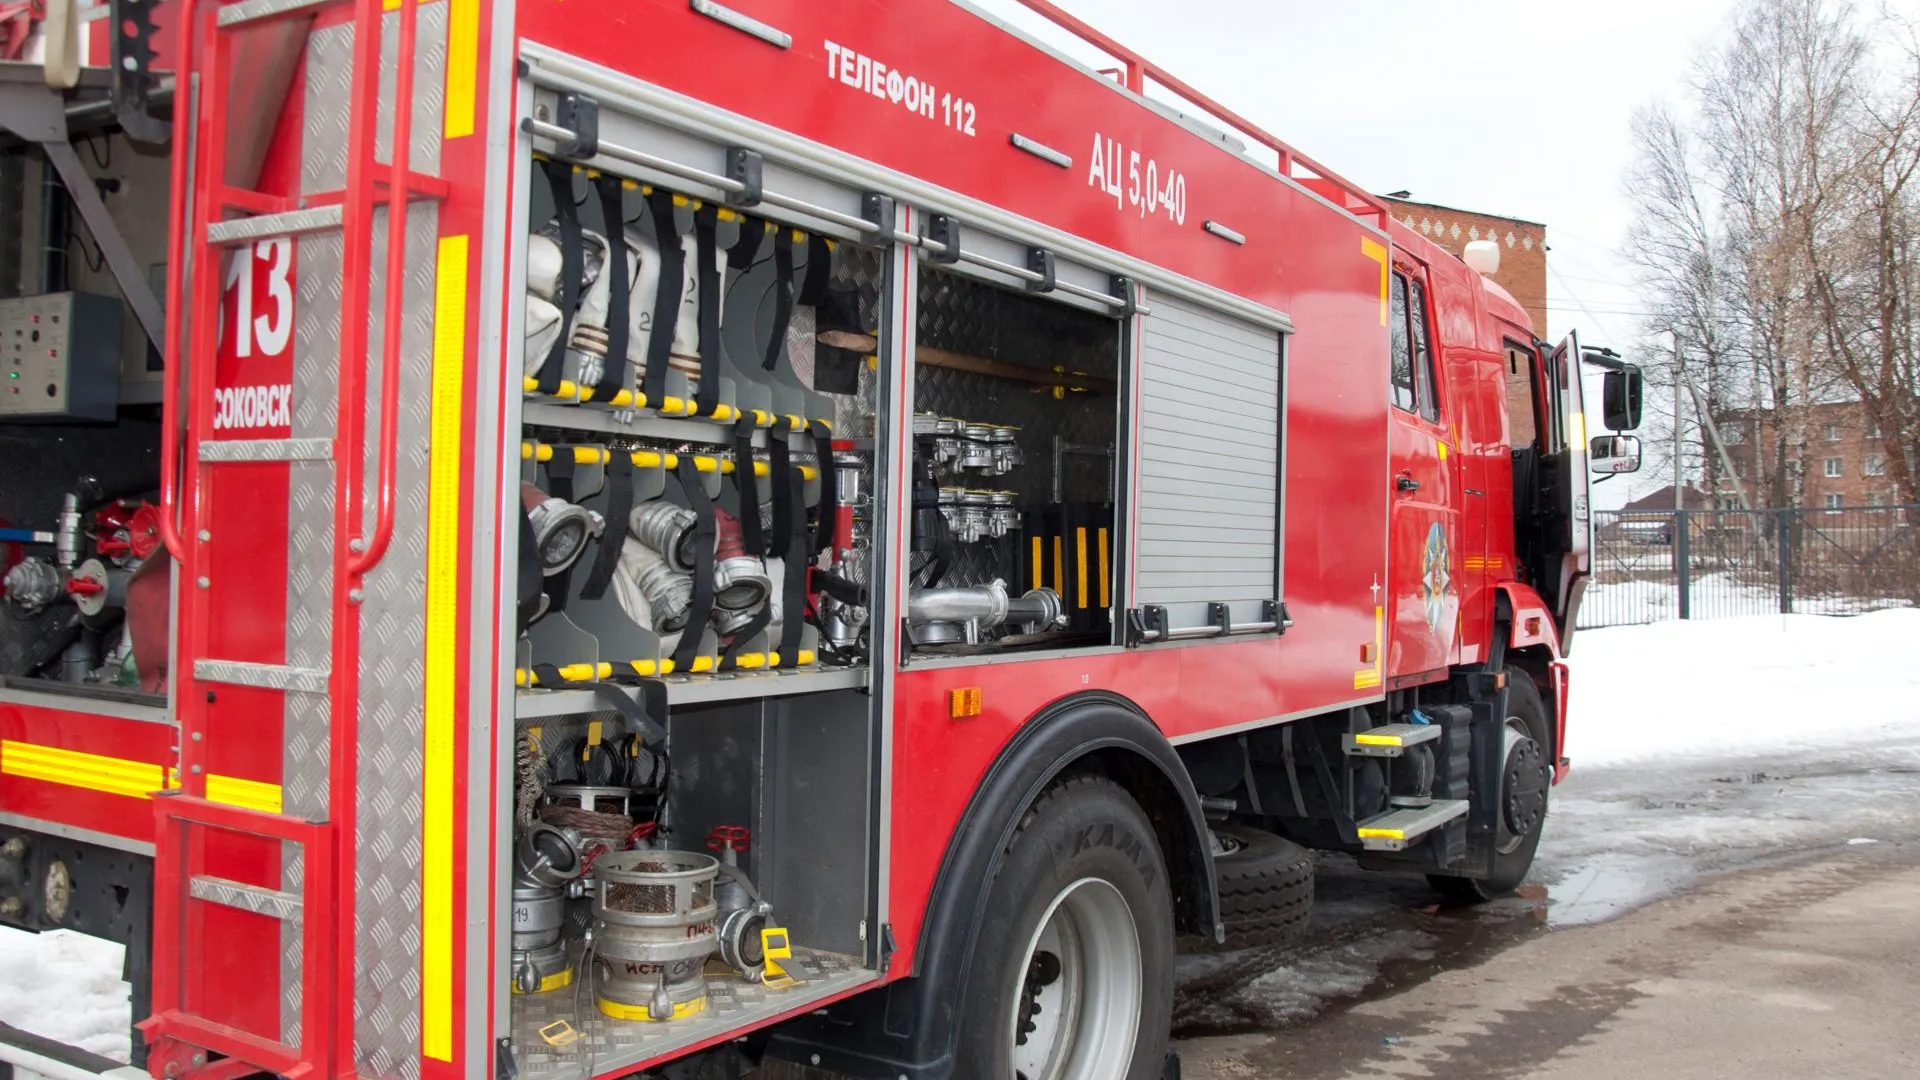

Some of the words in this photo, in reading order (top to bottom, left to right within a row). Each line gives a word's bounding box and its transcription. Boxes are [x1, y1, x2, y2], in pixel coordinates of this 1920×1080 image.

[824, 39, 935, 120] ТЕЛЕФОН
[941, 92, 976, 137] 112
[1088, 132, 1122, 211] АЦ
[1128, 150, 1186, 226] 5,0-40
[218, 236, 293, 358] 13
[639, 311, 651, 331] 2
[514, 907, 528, 922] 19
